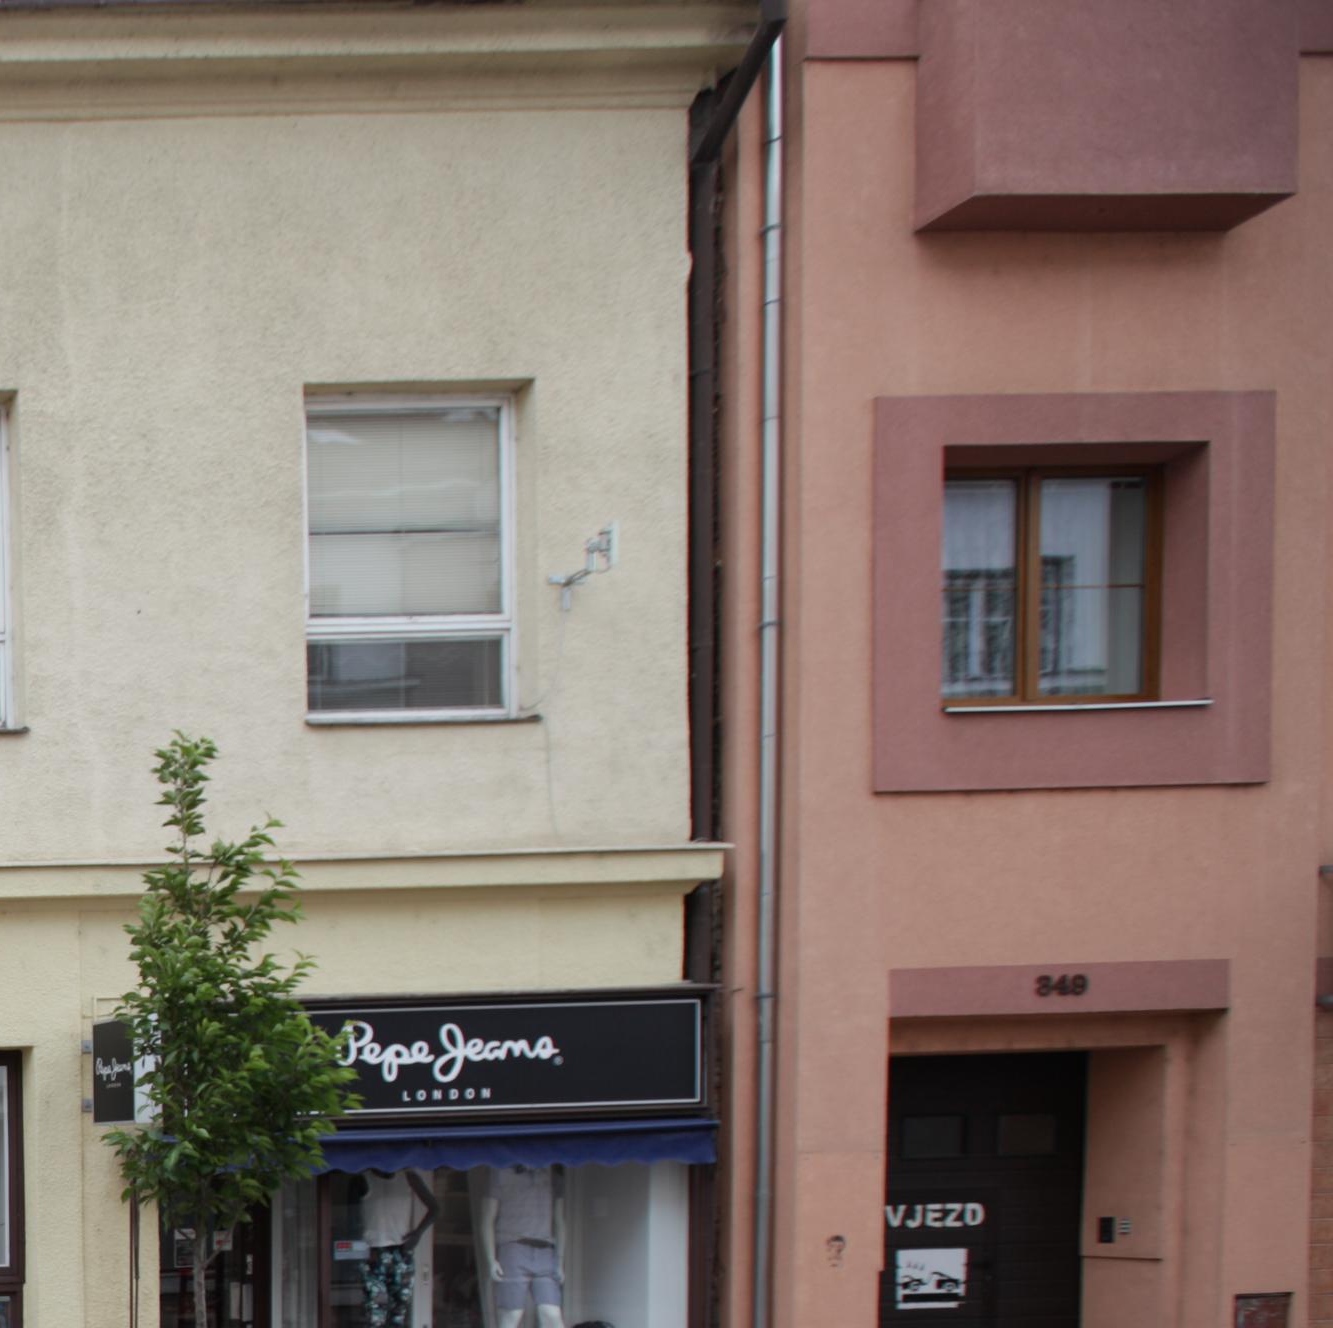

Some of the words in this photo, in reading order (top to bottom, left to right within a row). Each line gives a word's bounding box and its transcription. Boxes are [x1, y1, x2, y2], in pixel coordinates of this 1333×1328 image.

[1036, 975, 1089, 997] 349
[336, 1020, 434, 1083] Pepe
[402, 1088, 491, 1102] LONDON
[885, 1202, 986, 1229] VJEZD
